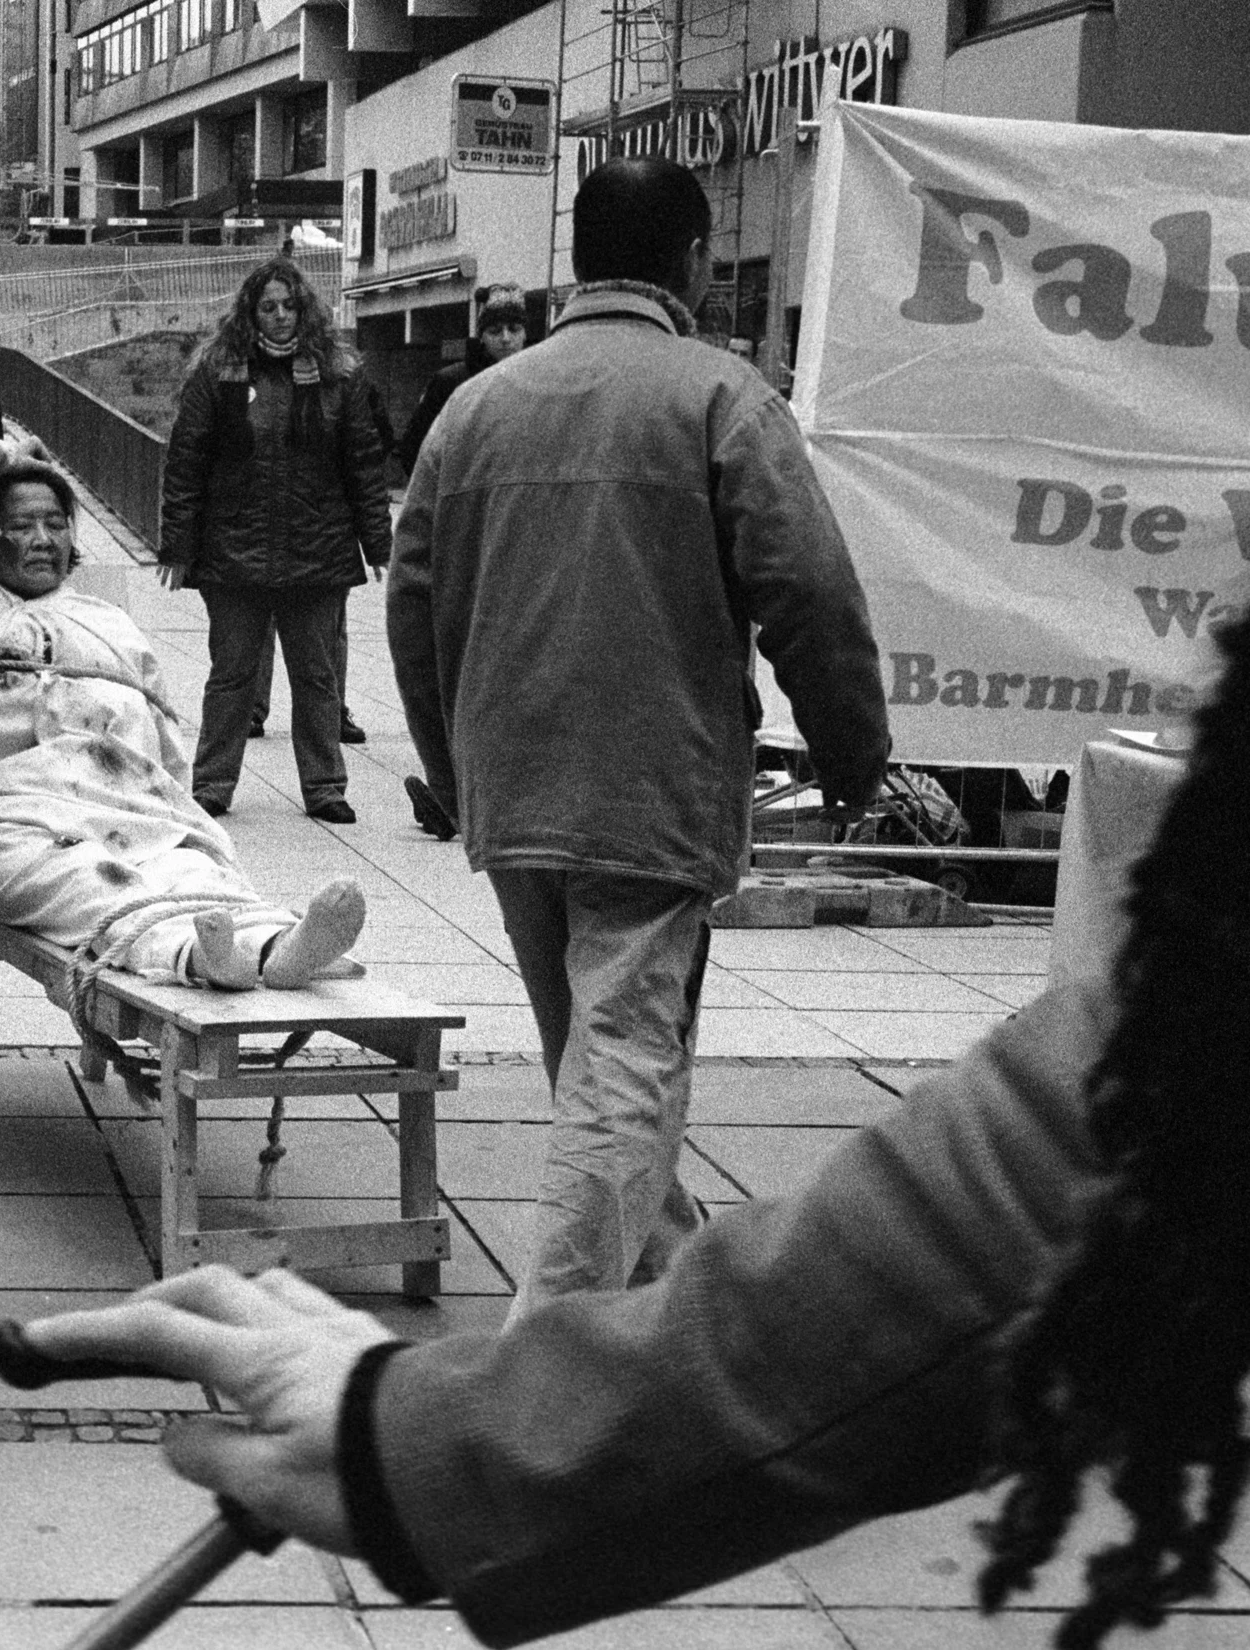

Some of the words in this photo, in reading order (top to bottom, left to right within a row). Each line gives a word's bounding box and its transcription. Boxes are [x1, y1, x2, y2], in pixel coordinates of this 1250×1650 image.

[475, 129, 533, 149] TAHN
[900, 178, 1250, 350] Fal
[1010, 478, 1187, 555] Die
